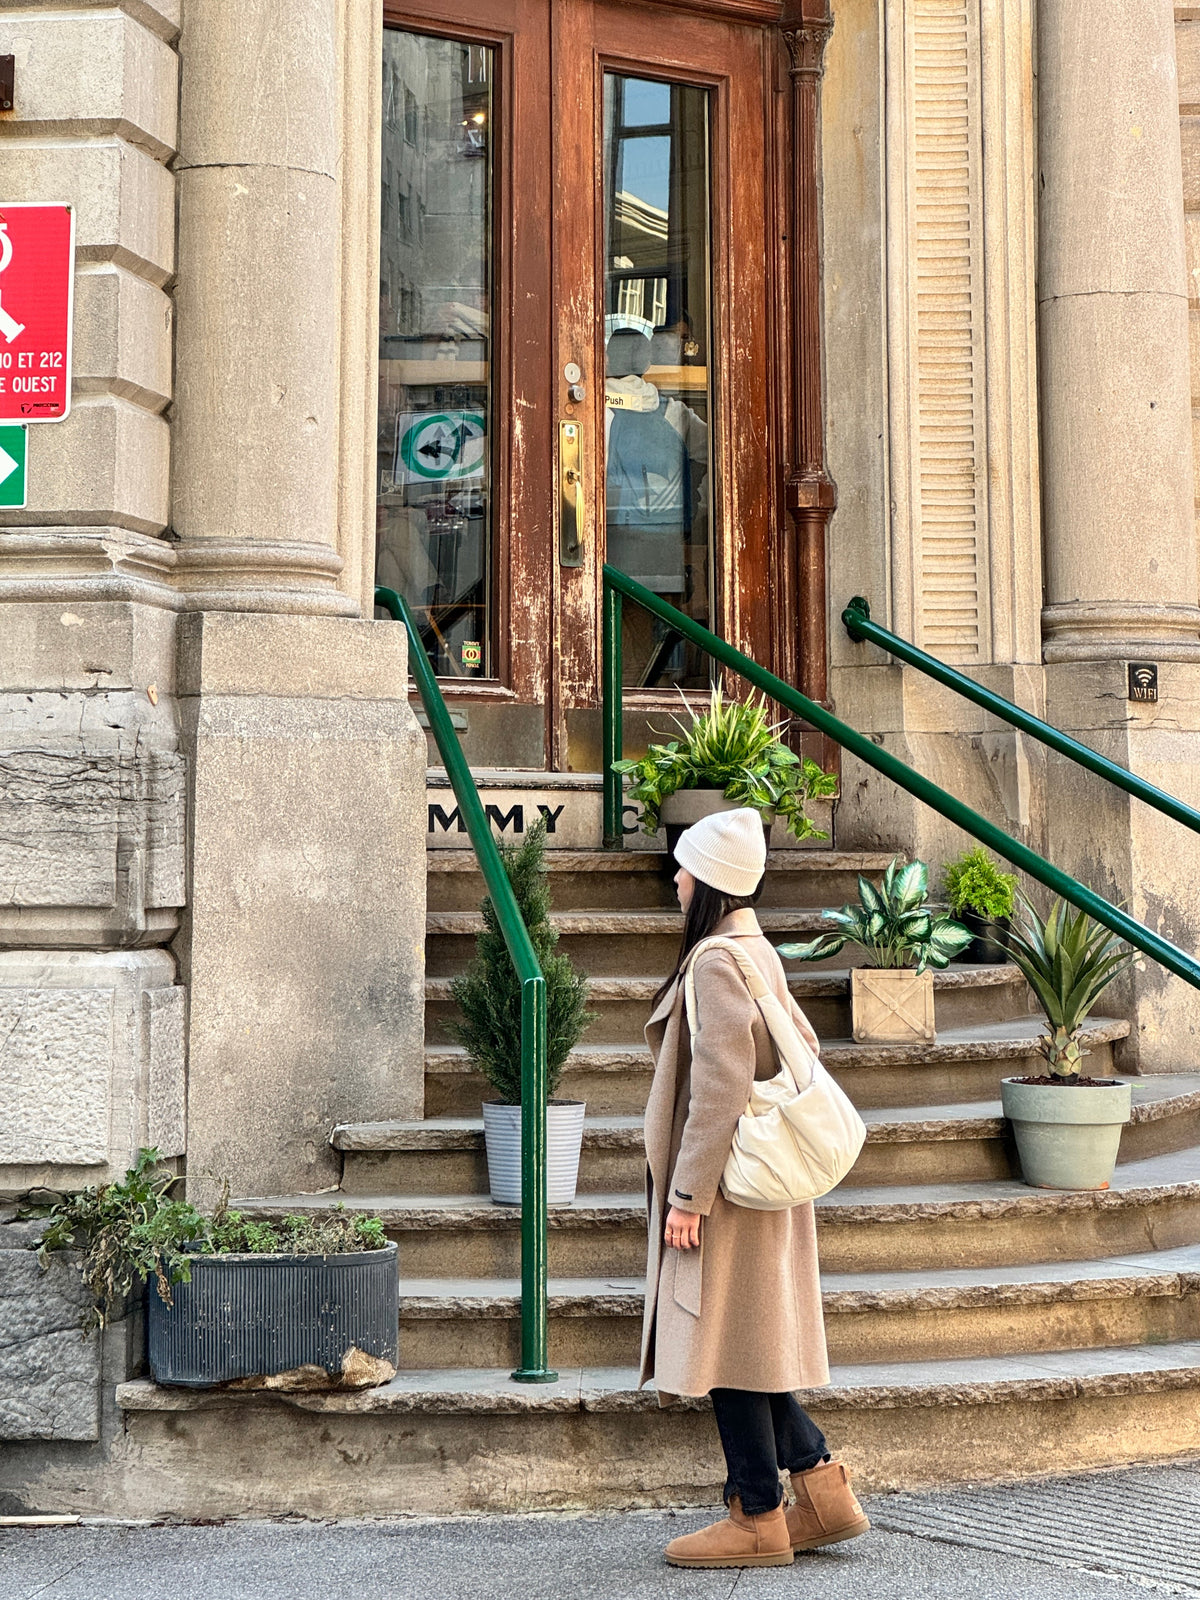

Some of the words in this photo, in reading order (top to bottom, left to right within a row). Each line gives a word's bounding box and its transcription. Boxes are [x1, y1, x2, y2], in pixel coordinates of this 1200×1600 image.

[18, 352, 35, 368] ET
[40, 351, 63, 368] 212
[12, 376, 58, 393] OUEST
[604, 395, 624, 406] Push
[1133, 687, 1157, 700] WIFI
